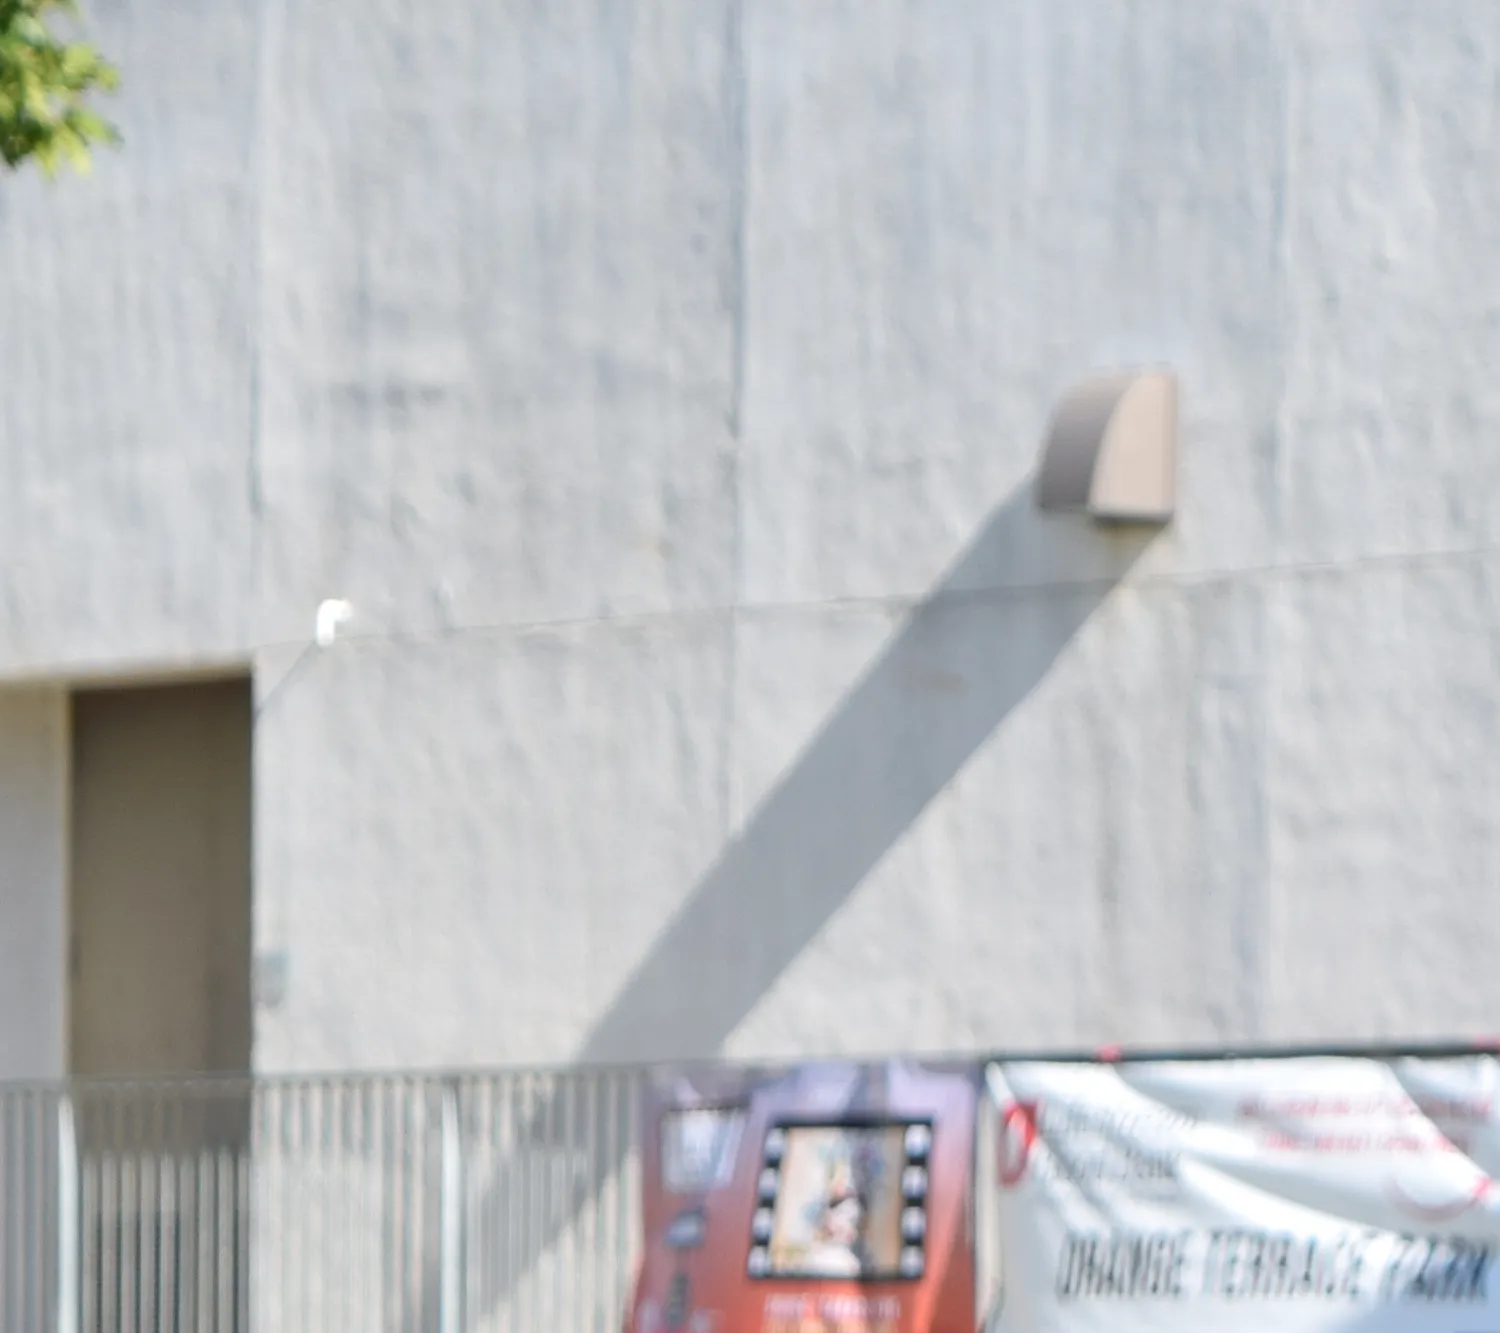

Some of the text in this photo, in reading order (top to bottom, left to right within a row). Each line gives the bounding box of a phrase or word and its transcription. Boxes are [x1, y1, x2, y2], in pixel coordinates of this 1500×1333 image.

[1057, 1230, 1497, 1304] ORANGE TERRACE PARK
